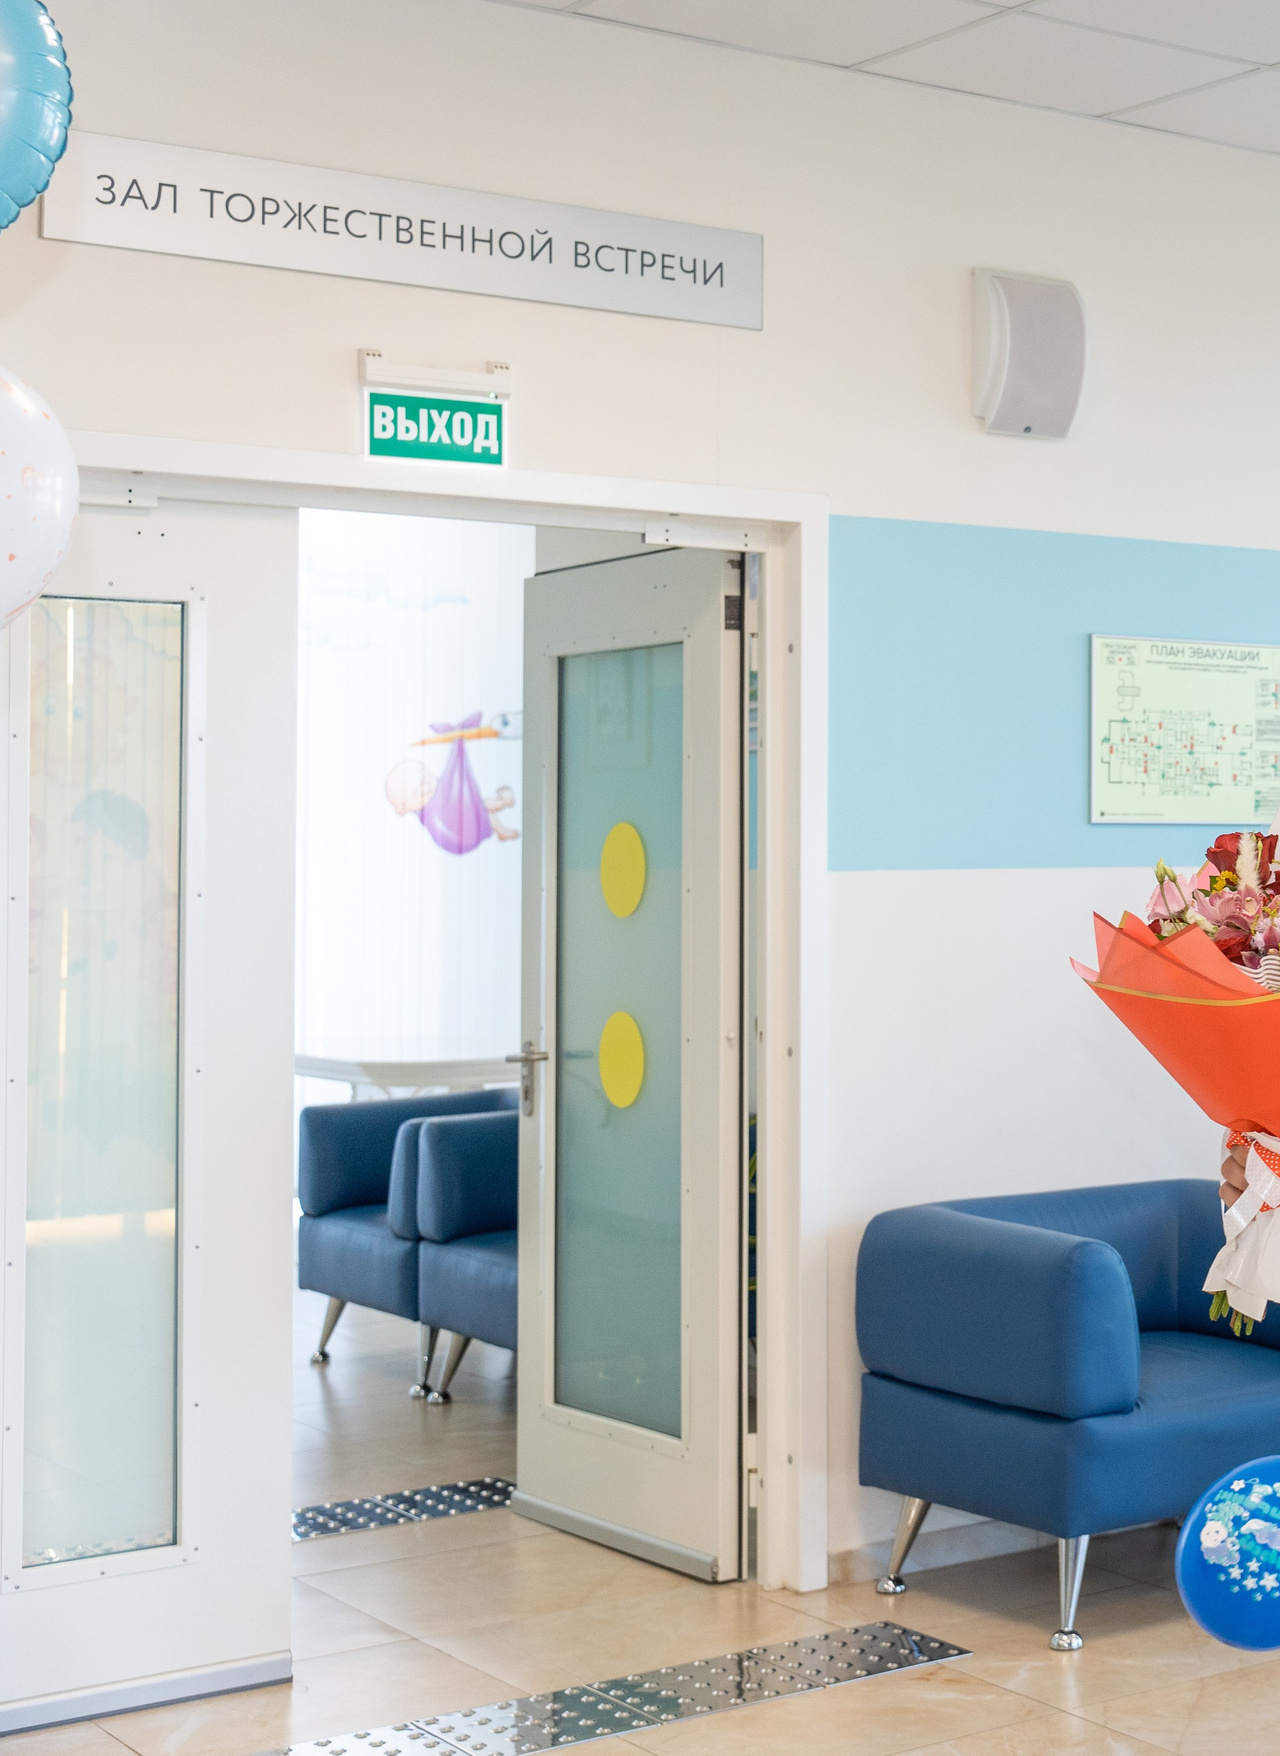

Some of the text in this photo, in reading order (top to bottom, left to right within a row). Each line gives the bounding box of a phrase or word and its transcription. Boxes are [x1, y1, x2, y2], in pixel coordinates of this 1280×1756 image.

[95, 174, 725, 289] ЗАЛ ТОРЖЕСТВЕННОЙ ВСТРЕЧИ
[372, 404, 500, 454] ВЫХОД
[1150, 644, 1186, 658] ПЛАН
[1187, 646, 1260, 662] ЭВАКУАЦИИ
